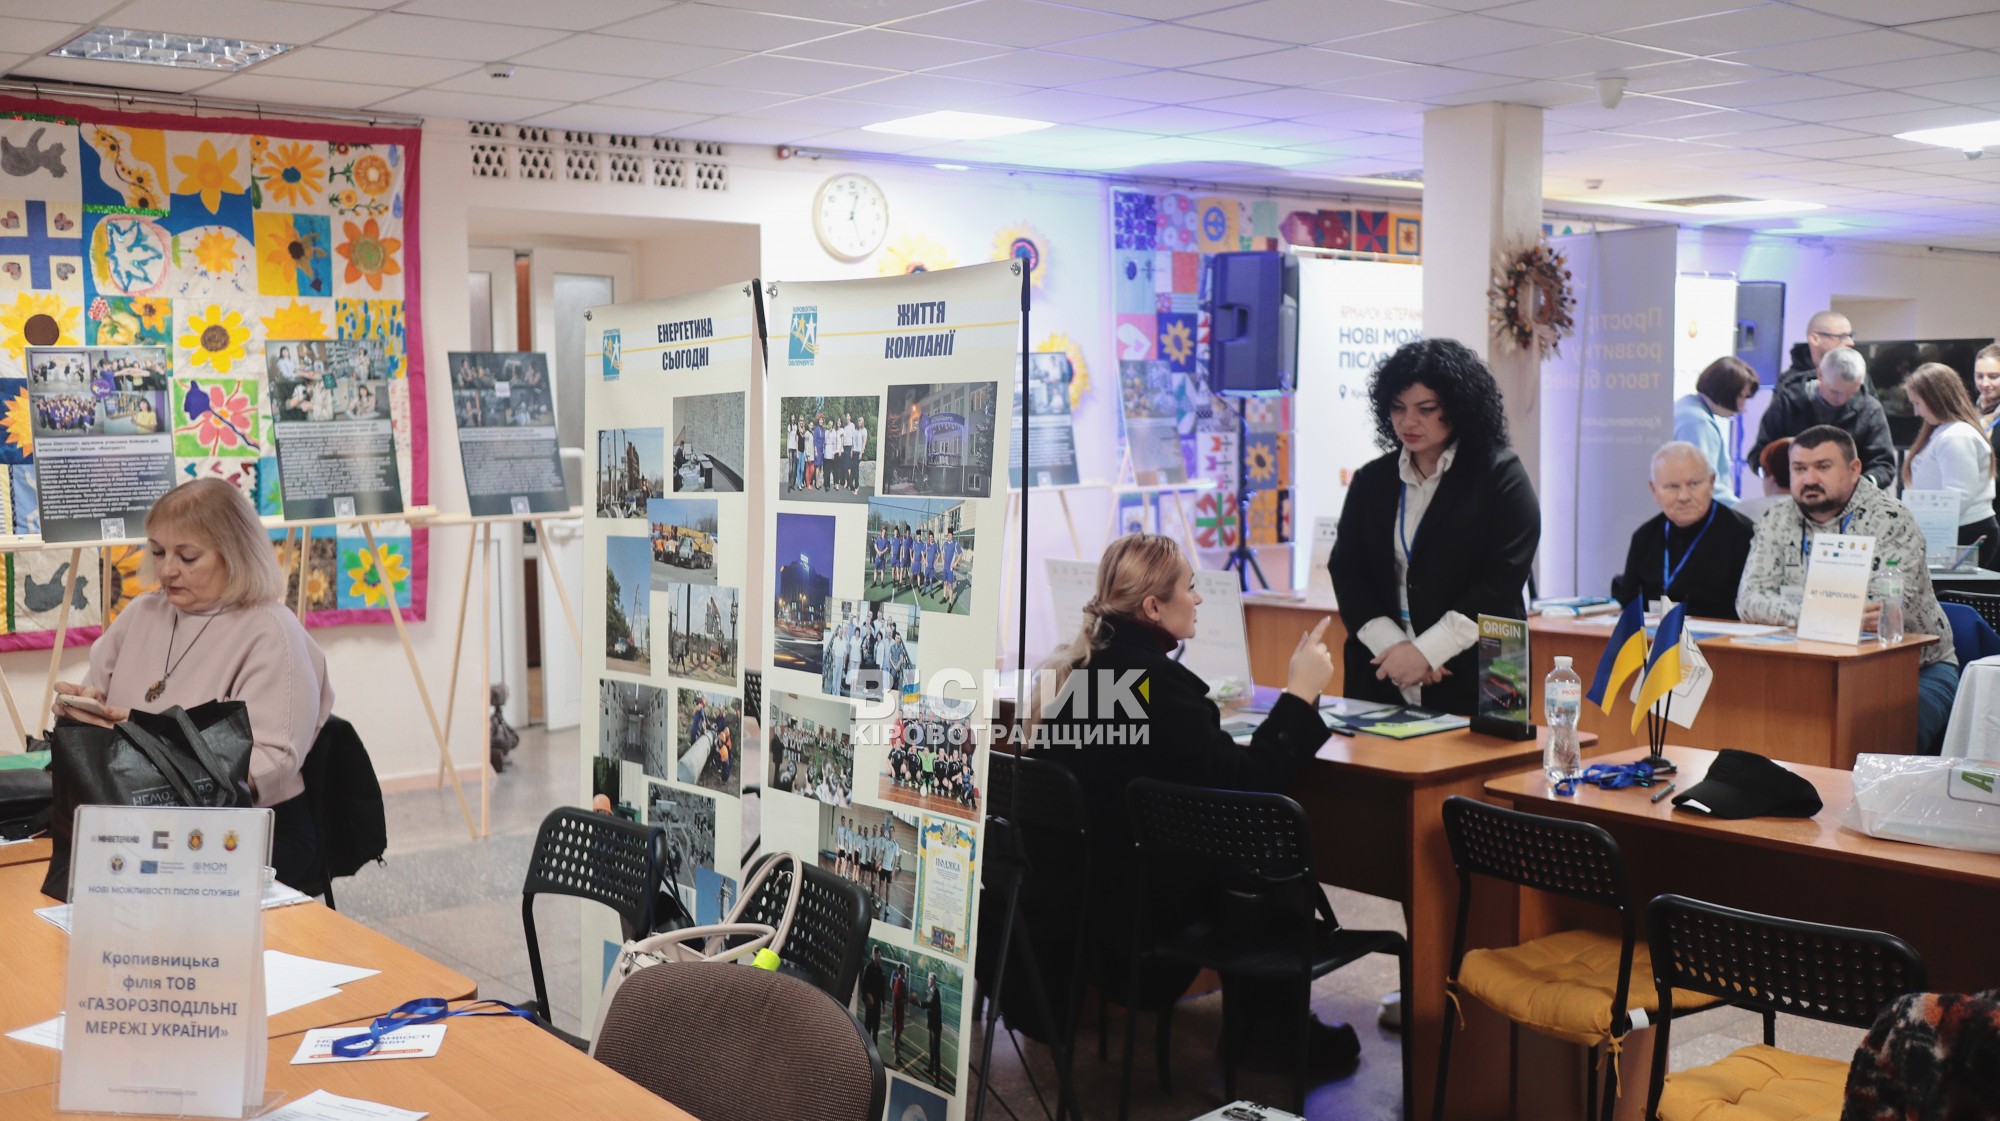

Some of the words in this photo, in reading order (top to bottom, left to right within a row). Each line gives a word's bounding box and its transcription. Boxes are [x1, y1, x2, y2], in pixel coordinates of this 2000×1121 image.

[897, 301, 946, 326] ЖИТТЯ
[657, 317, 713, 343] ЕНЕРГЕТИКА
[1339, 327, 1379, 344] НОВІ
[884, 329, 956, 359] КОМПАНІЇ
[662, 347, 709, 371] СЬОГОДНІ
[1483, 620, 1521, 639] ORIGIN
[111, 886, 171, 896] МОЖЛИВОСТІ
[173, 888, 200, 896] ПІСЛЯ
[201, 889, 240, 897] СЛУЖБИ
[102, 951, 220, 970] Кропивницька
[122, 975, 161, 992] філія
[166, 977, 197, 990] ТОВ
[78, 997, 238, 1017] «ГАЗОРОЗПОДІЛЬНІ
[85, 1021, 147, 1036] МЕРЕЖІ
[151, 1022, 229, 1039] УКРАЇНИ»
